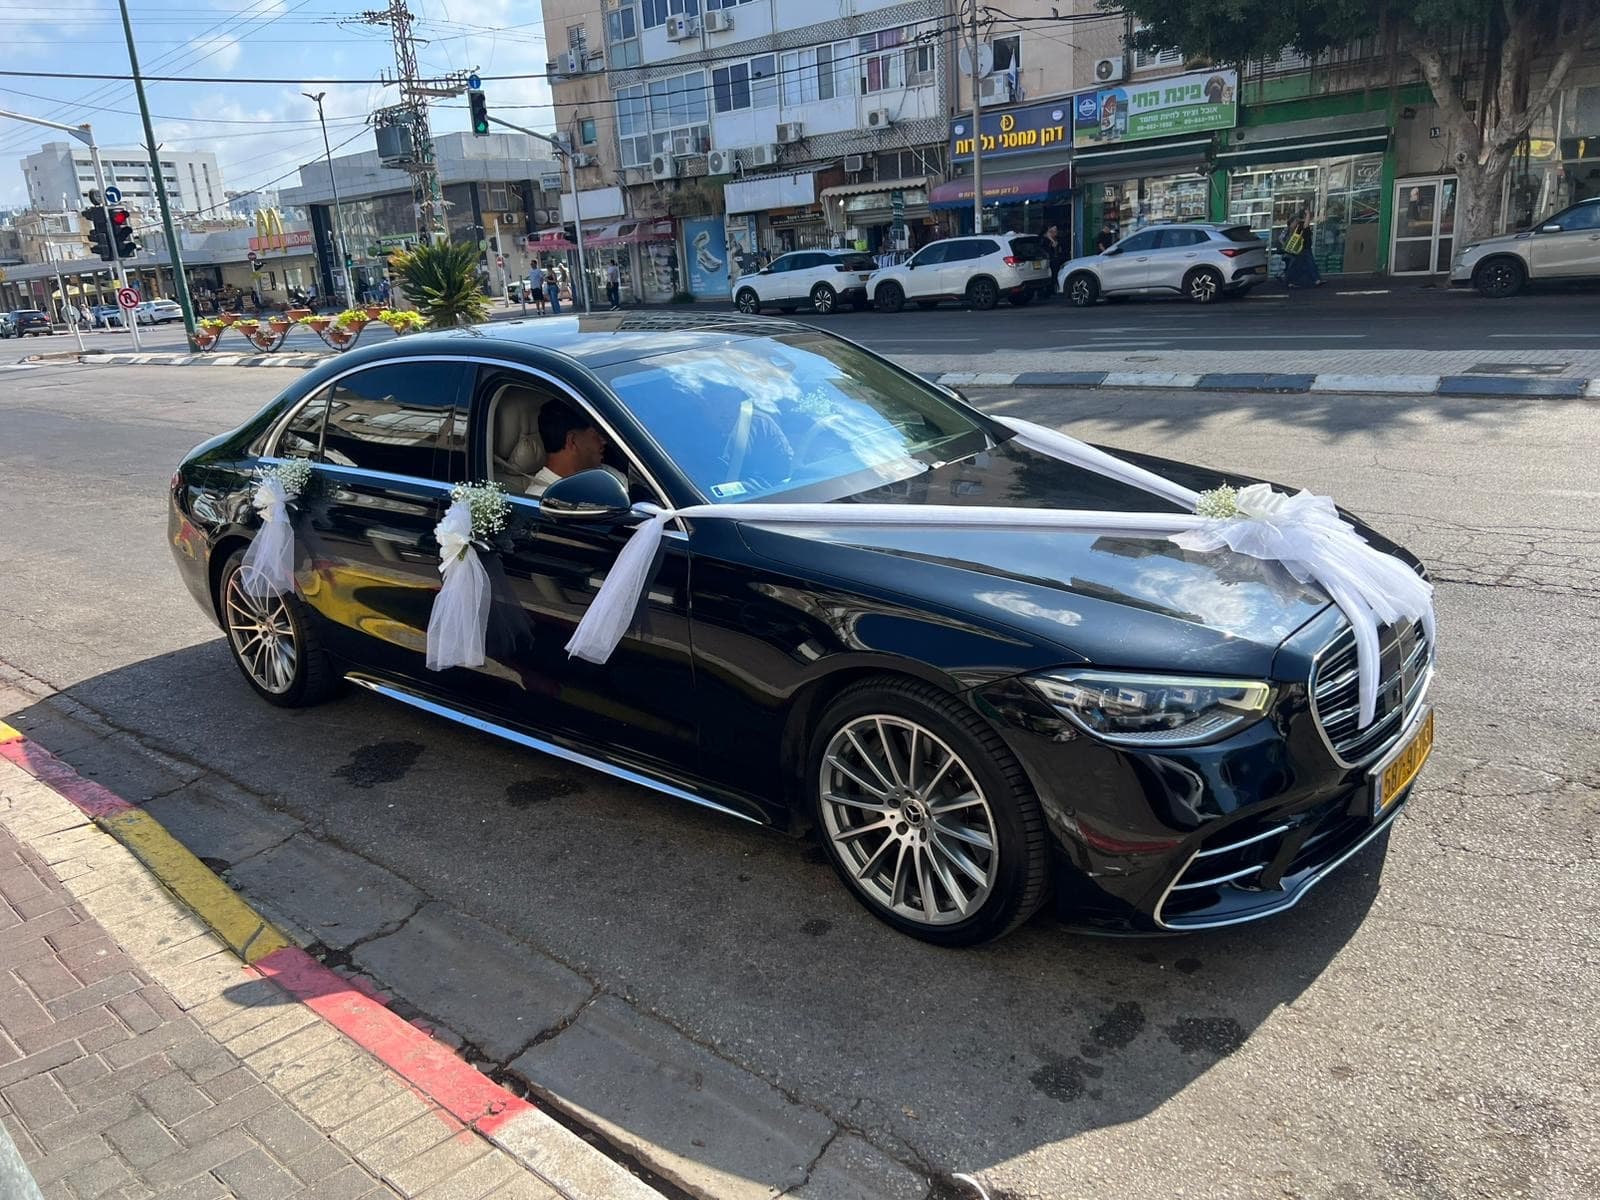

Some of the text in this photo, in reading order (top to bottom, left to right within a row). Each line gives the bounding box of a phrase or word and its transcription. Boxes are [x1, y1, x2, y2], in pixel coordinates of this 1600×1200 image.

[1132, 84, 1202, 108] פינת החי
[955, 126, 1064, 154] דהן מחסני גלדות
